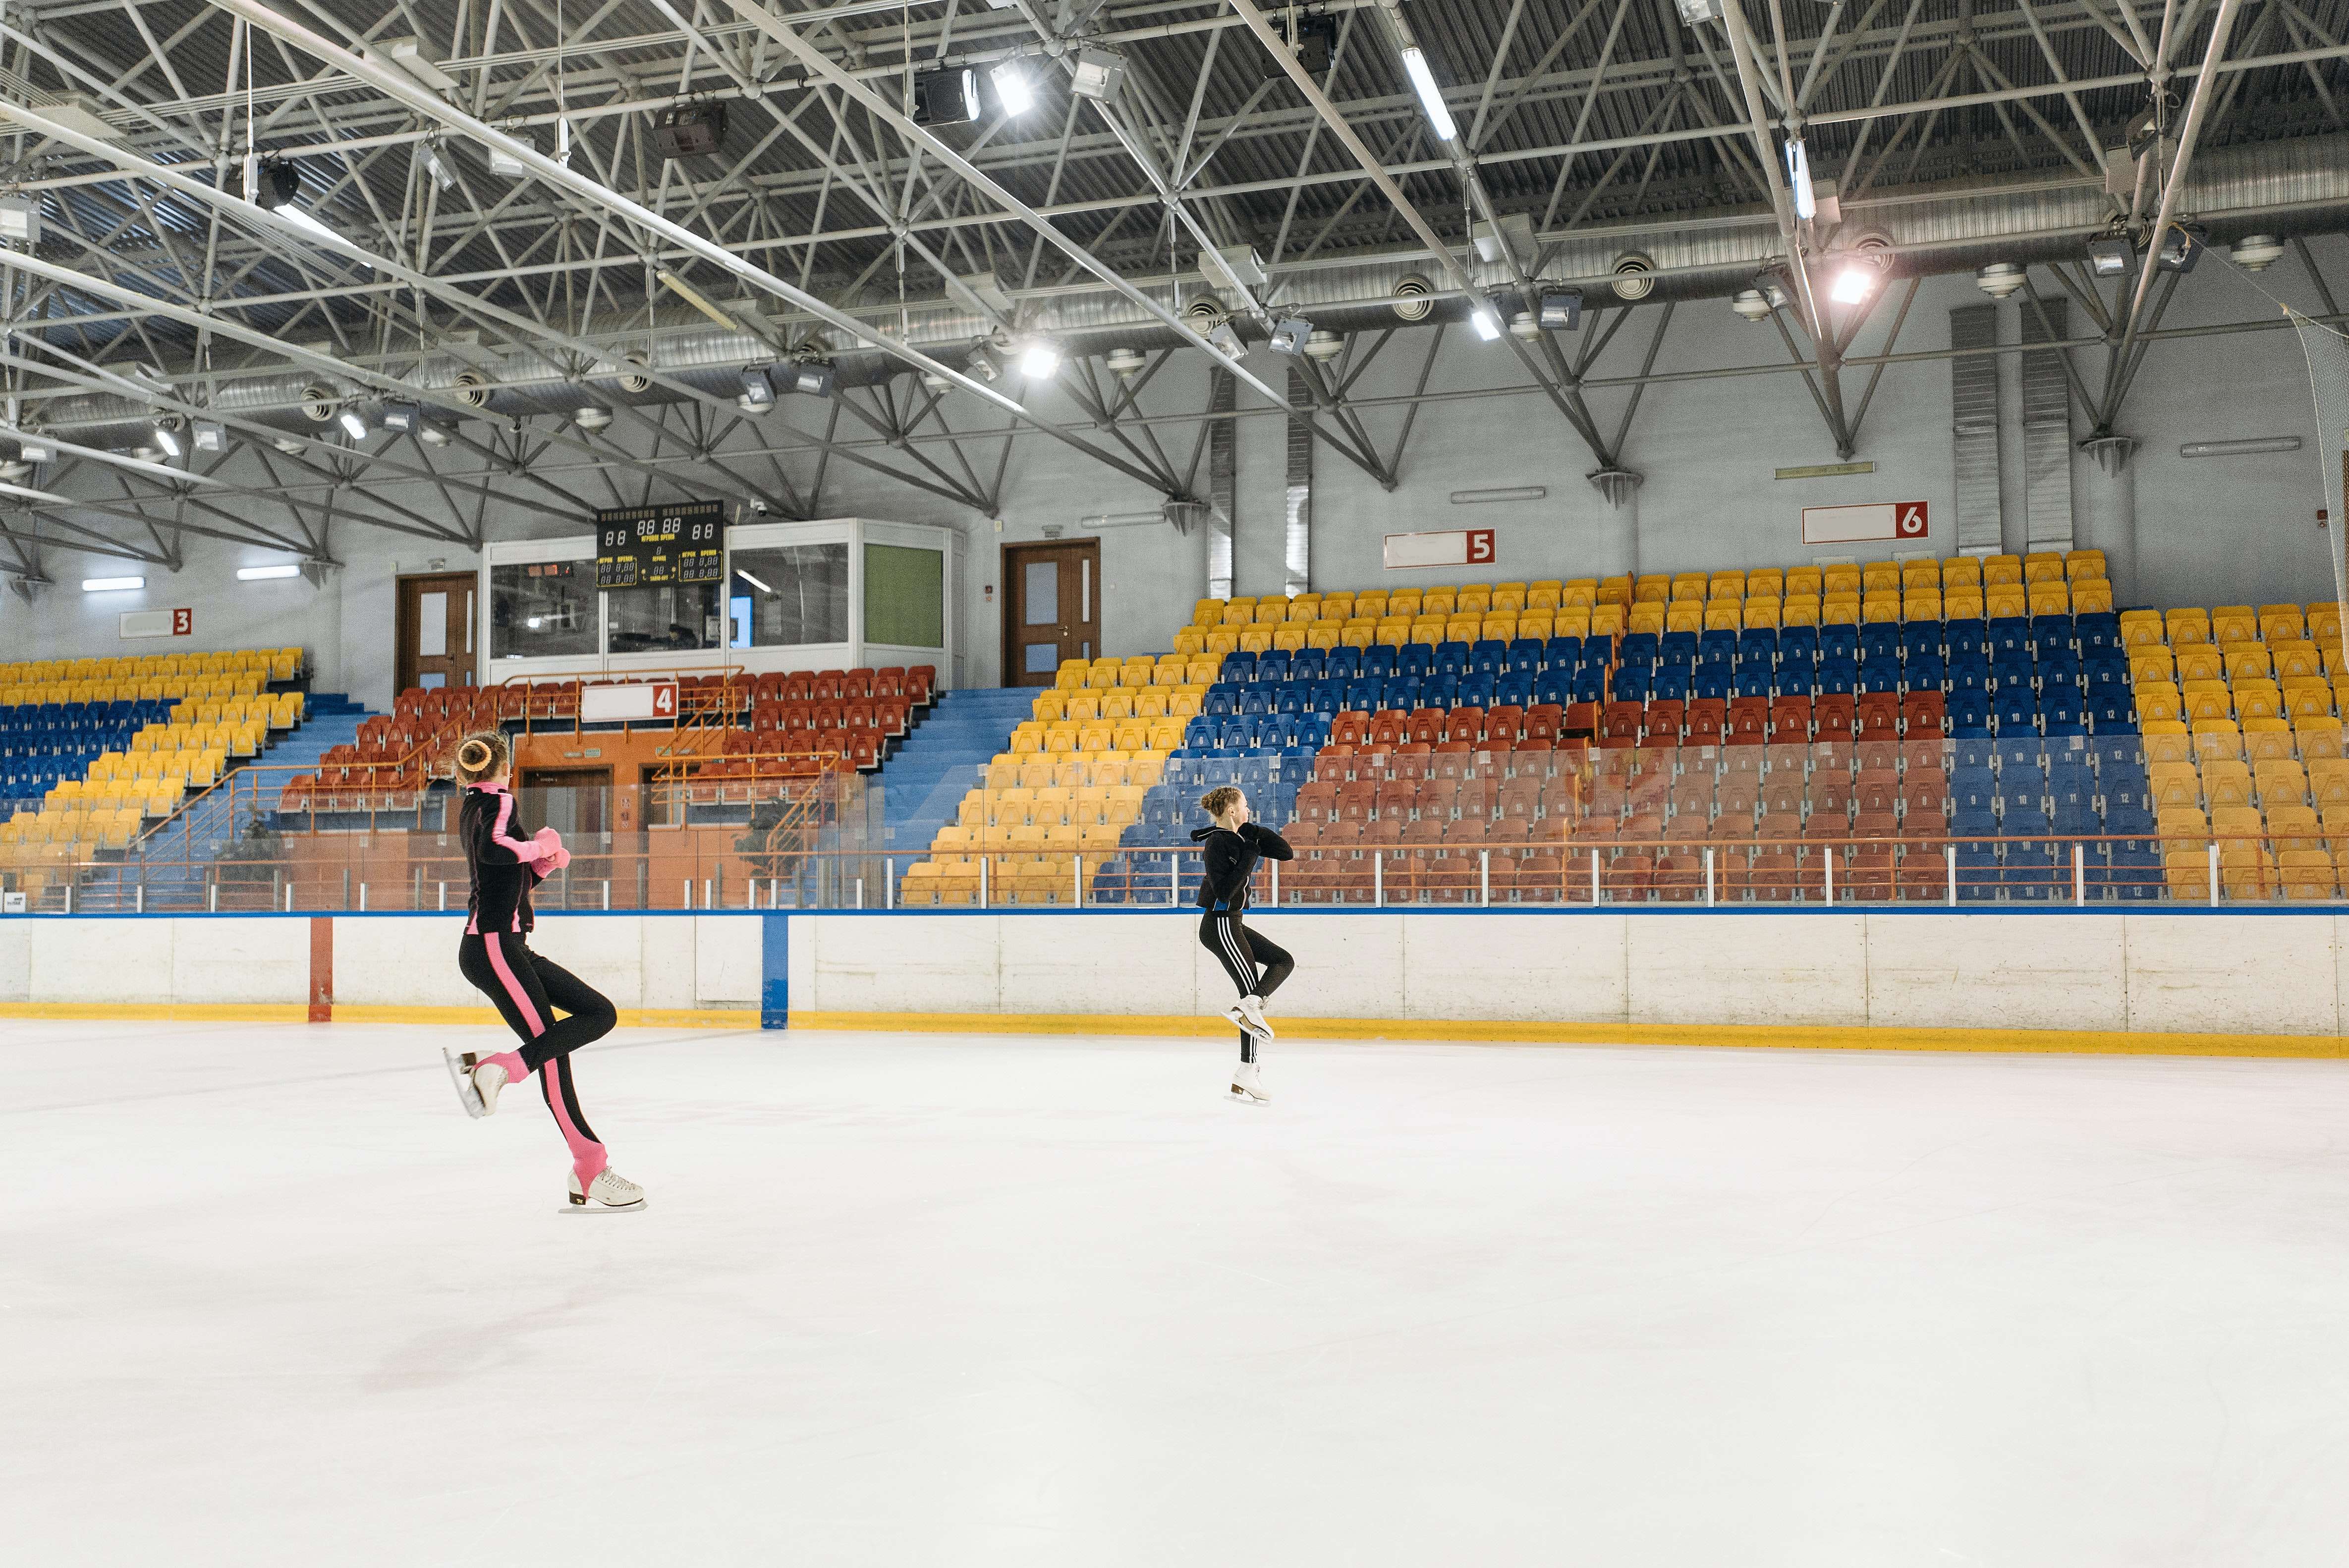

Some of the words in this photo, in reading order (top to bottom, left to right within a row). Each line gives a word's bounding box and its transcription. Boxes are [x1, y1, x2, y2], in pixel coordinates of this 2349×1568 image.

[1903, 506, 1922, 533] 6
[1474, 534, 1490, 559] 5
[177, 611, 189, 632] 3
[657, 688, 671, 713] 4
[1662, 723, 1666, 731] 2
[1878, 718, 1881, 726] 7
